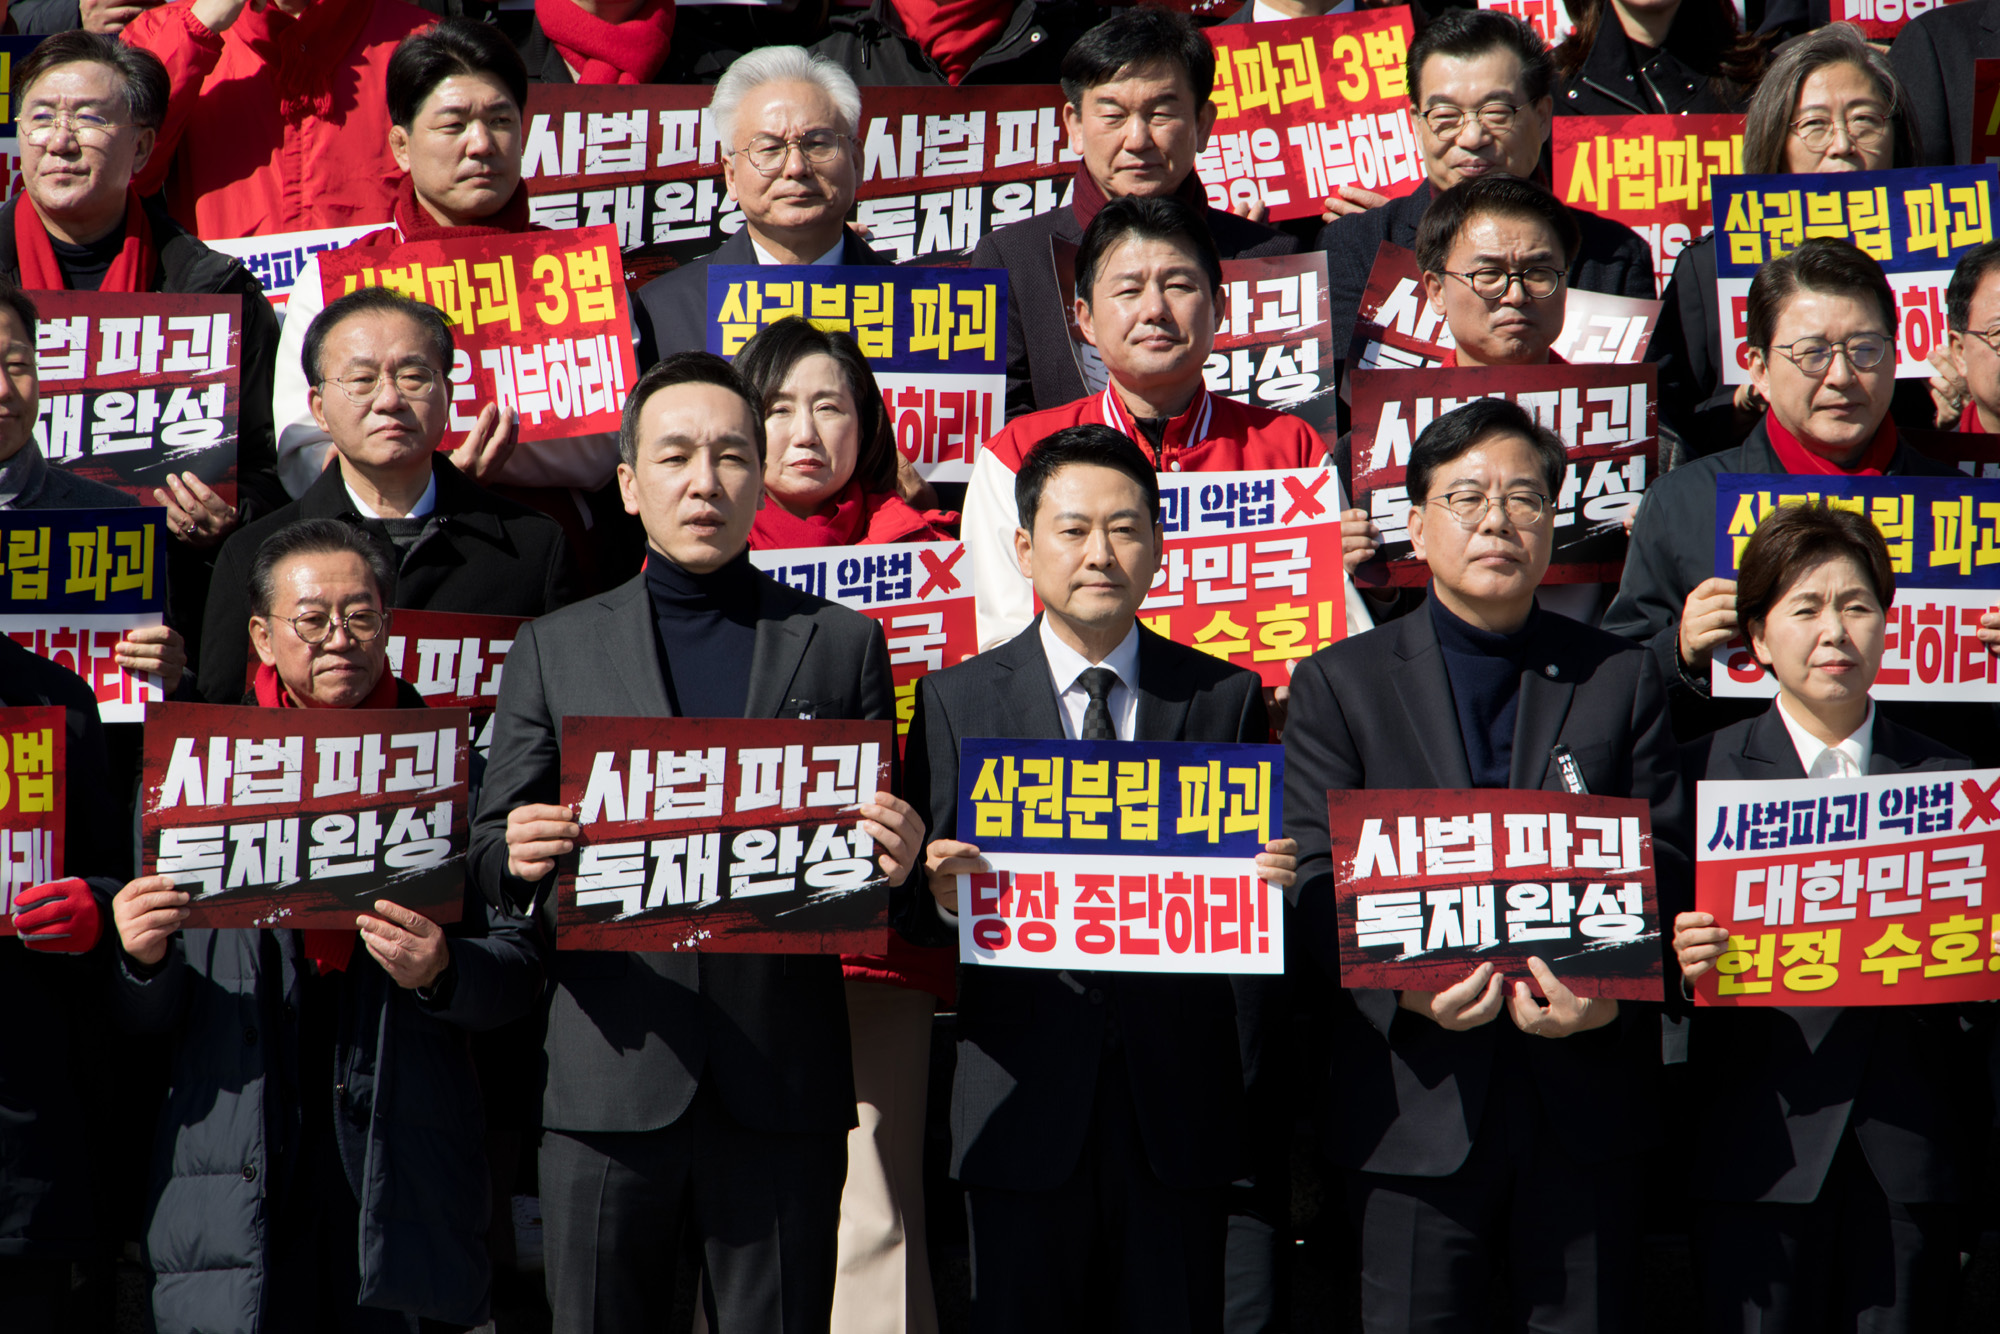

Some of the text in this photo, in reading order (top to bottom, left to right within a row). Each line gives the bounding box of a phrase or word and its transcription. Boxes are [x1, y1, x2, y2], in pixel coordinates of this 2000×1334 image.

[1208, 36, 1325, 120] 법파괴
[1333, 25, 1410, 102] 3법
[521, 107, 720, 178] 사법 파
[863, 107, 1082, 180] 사법 파
[1194, 127, 1291, 211] 통령은
[1566, 135, 1743, 210] 사법파괴
[857, 178, 1074, 263] 독재 완
[1724, 187, 1893, 264] 삼권분립
[1904, 180, 1993, 258] 파괴
[533, 246, 616, 325] 3법
[909, 283, 997, 361] 파괴
[1373, 277, 1455, 349] 사
[36, 313, 231, 381] 법 파괴
[481, 334, 626, 425] 거부하라!
[32, 383, 226, 459] 재 완성
[882, 386, 992, 464] 하라!
[1370, 383, 1647, 469] 사 파괴
[1200, 479, 1275, 528] 악법
[1727, 491, 1914, 573] 삼립
[65, 524, 155, 601] 파괴
[837, 552, 912, 603] 악법
[1138, 537, 1312, 610] 한민국
[1192, 600, 1333, 662] 수호!
[157, 736, 304, 807] 사법
[313, 728, 457, 798] 파괴
[578, 742, 880, 823] 사법 파괴
[970, 755, 1271, 844] 삼권분립 파괴
[156, 800, 453, 894] 독재 완성
[1352, 812, 1641, 877] 사법 파괴
[1707, 782, 1954, 851] 사법파괴 악법
[575, 820, 875, 913] 독재 완성
[1733, 844, 1988, 926] 대한민국
[970, 870, 1269, 956] 당장 중단하라!
[1355, 882, 1646, 956] 독재 완성
[1716, 928, 1842, 996] 헌정
